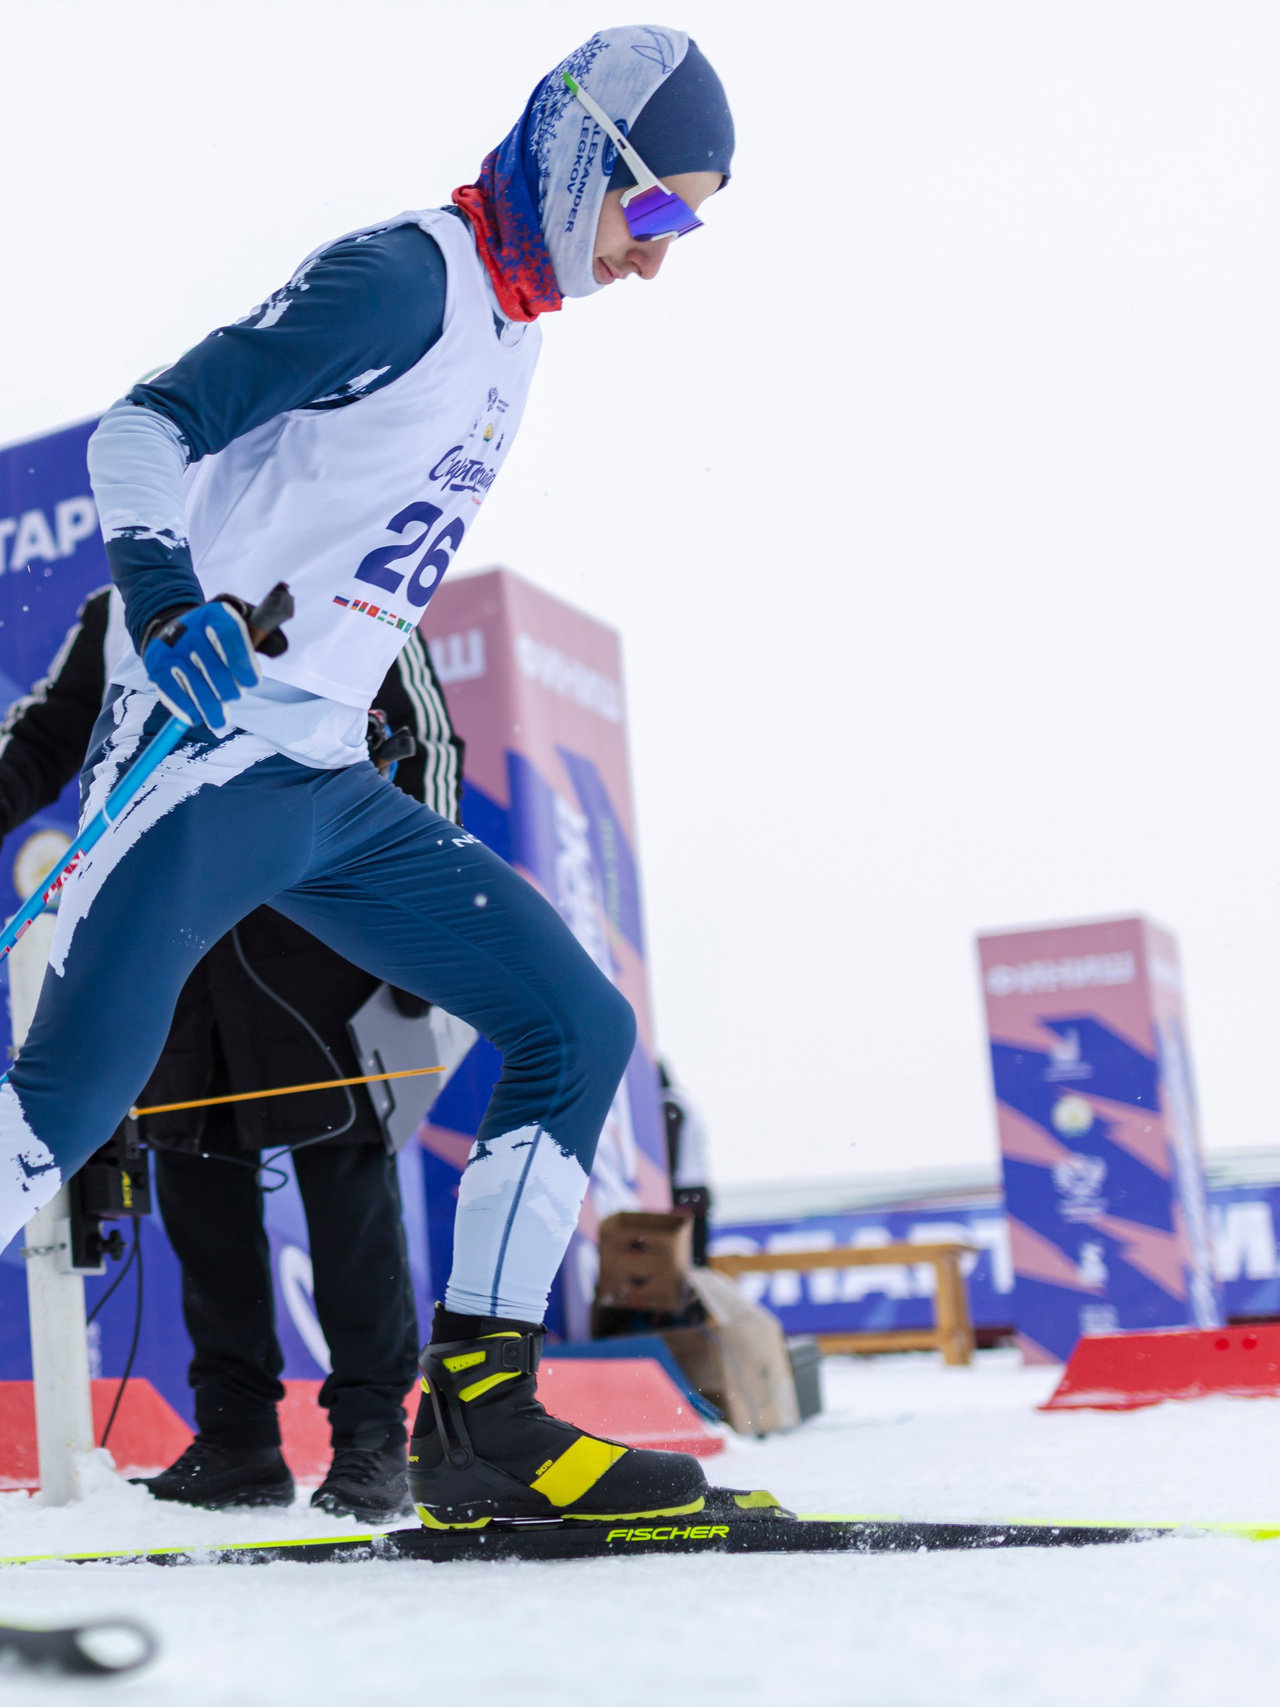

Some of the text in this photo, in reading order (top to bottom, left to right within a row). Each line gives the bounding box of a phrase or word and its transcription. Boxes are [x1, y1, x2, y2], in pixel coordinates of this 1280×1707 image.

[566, 115, 592, 195] LEGKOV
[354, 501, 465, 607] 26
[605, 1525, 730, 1543] FISCHER
